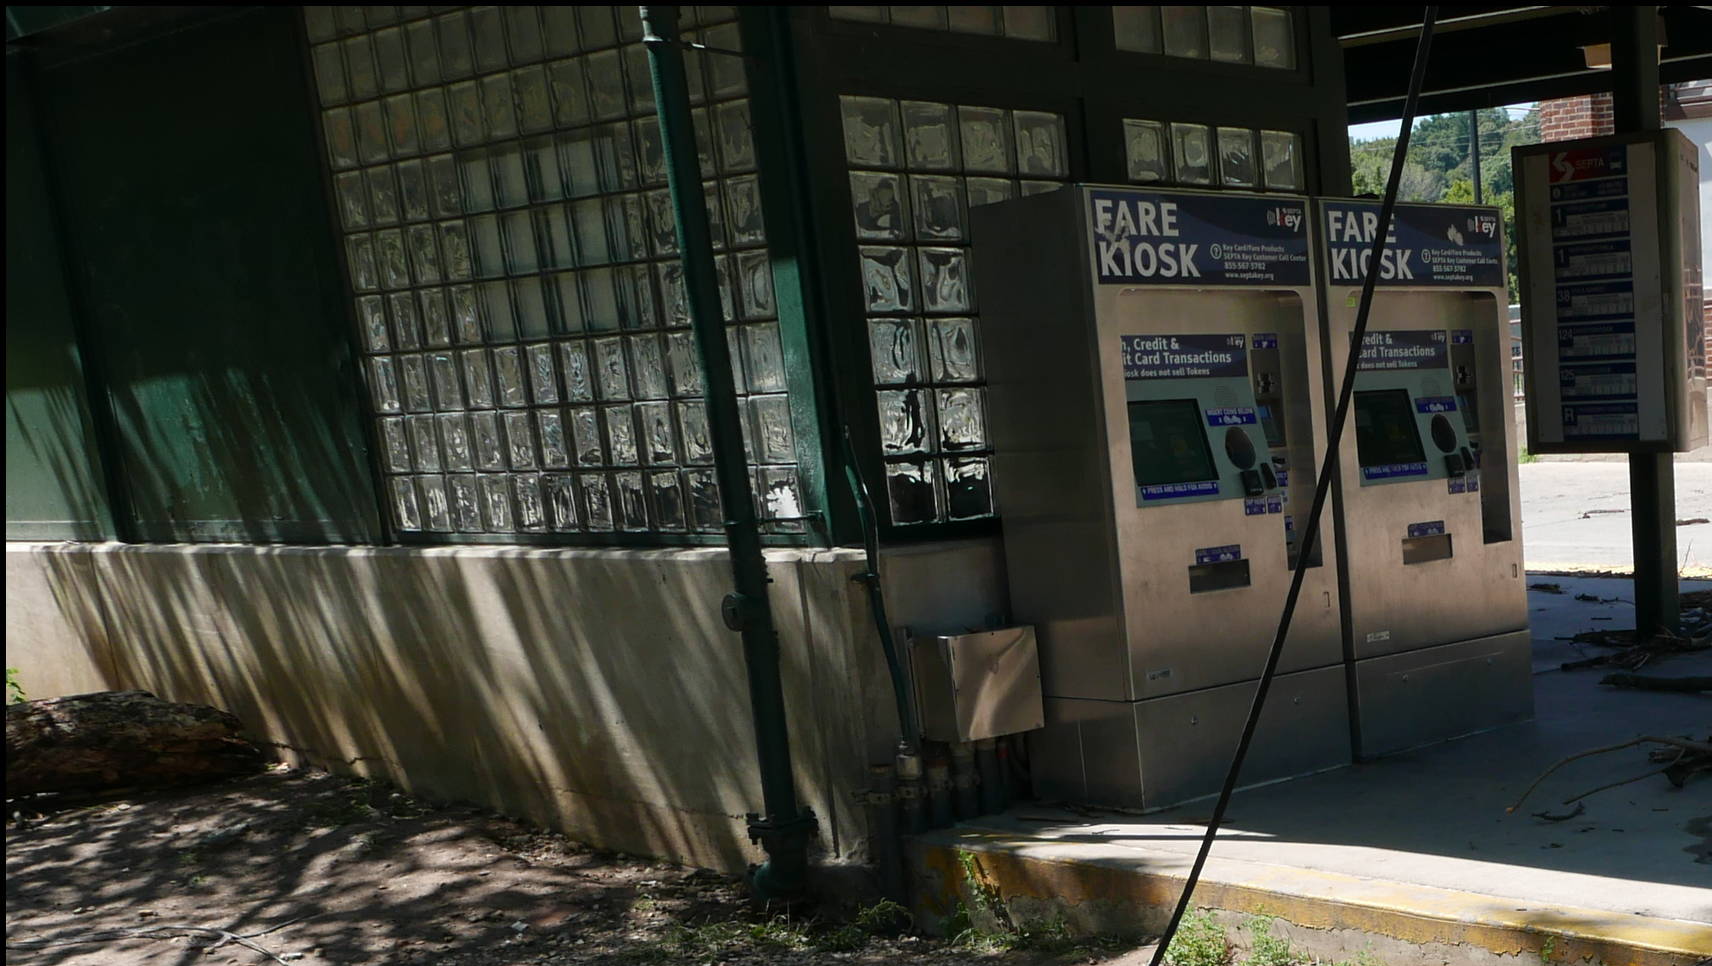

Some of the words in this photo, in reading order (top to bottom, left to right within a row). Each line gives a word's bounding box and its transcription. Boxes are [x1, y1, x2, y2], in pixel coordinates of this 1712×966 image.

[1575, 157, 1606, 169] SEPTA
[1094, 199, 1180, 237] FARE
[1098, 241, 1201, 279] KIOSK
[1223, 252, 1240, 260] SEPTA
[1242, 253, 1252, 262] Key
[1557, 288, 1570, 302] 38
[1362, 333, 1383, 345] redit
[1385, 333, 1393, 345] &
[1559, 328, 1573, 340] 124
[1133, 337, 1169, 351] Credit
[1170, 338, 1180, 351] &
[1135, 352, 1160, 366] Card
[1162, 350, 1232, 365] Transactions
[1360, 347, 1377, 359] ard
[1379, 345, 1436, 358] Transactions
[1141, 369, 1157, 377] does
[1172, 368, 1185, 376] sell
[1187, 367, 1210, 376] Tokens
[1564, 407, 1575, 422] R
